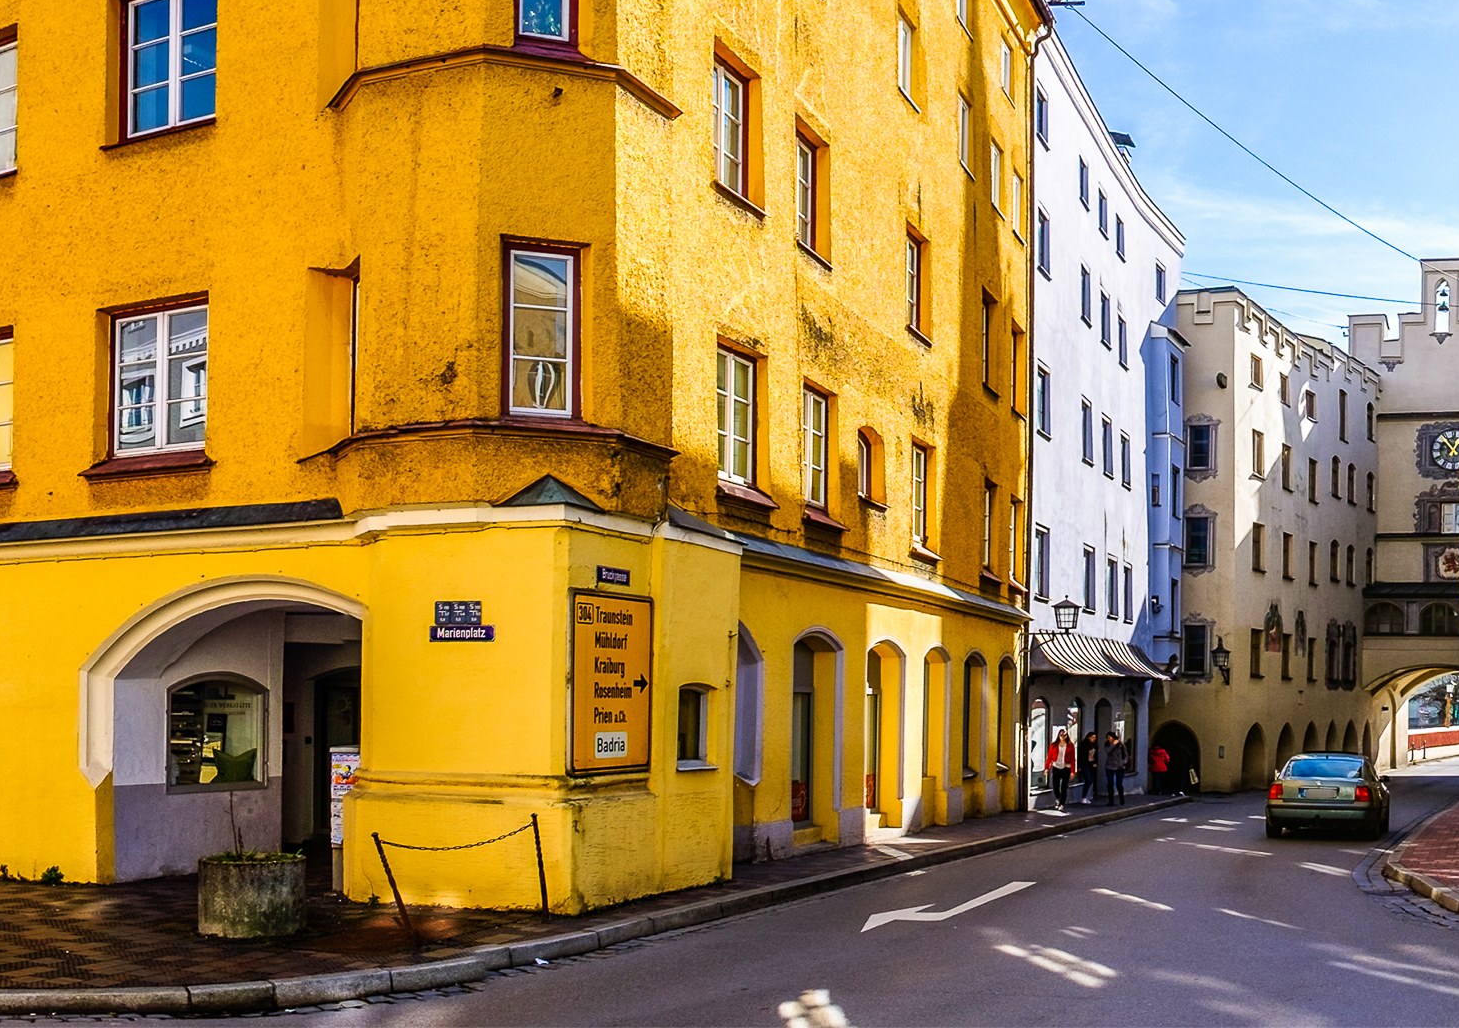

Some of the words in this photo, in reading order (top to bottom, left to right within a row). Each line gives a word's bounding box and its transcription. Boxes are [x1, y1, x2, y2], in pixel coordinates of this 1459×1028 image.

[578, 604, 592, 622] 304
[595, 606, 633, 626] Traunstein
[436, 627, 486, 639] Marienplatz
[594, 631, 628, 650] Mühldorf
[594, 656, 625, 678] Kraiburg
[594, 681, 633, 699] Rosenheim
[594, 707, 613, 724] Prien
[597, 736, 626, 753] Badria
